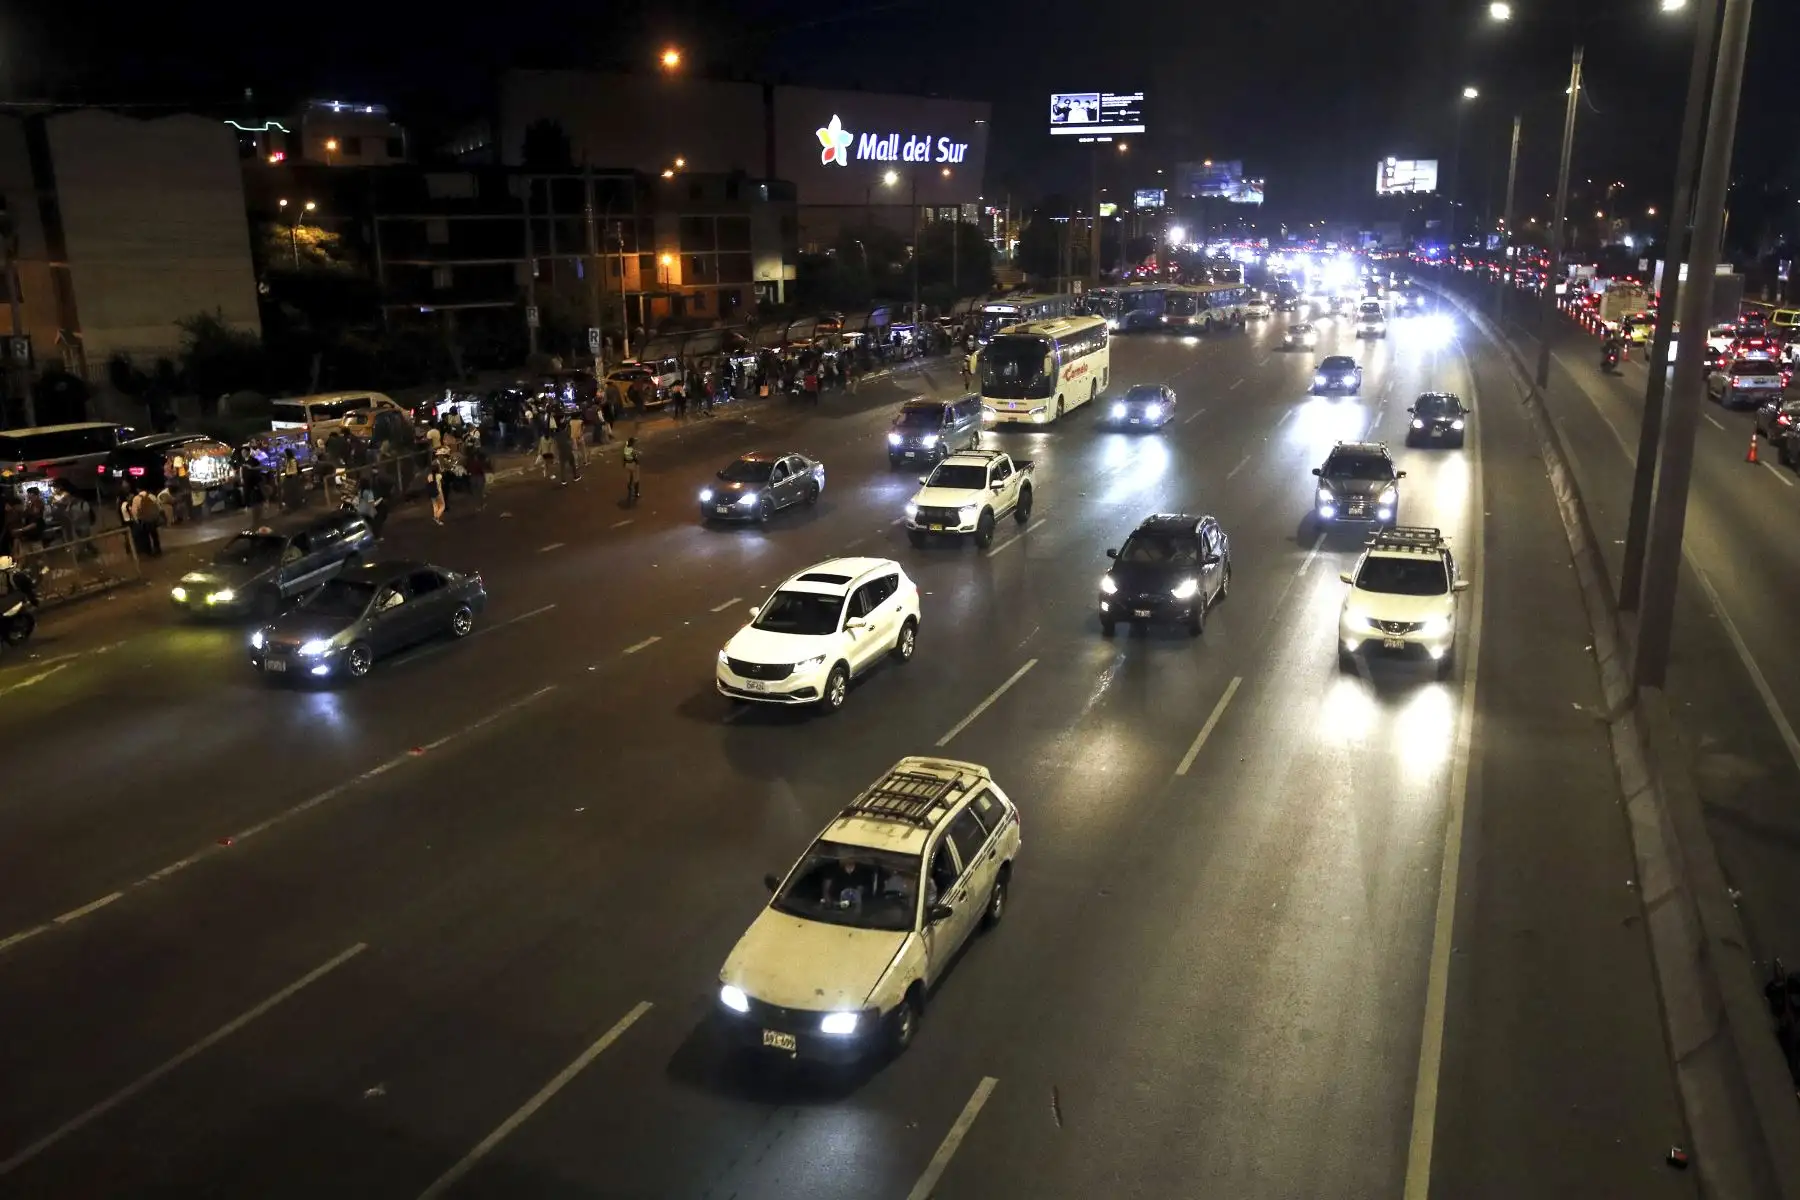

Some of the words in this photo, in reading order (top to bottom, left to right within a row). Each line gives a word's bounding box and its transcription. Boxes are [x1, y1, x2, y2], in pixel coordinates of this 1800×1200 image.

[856, 132, 900, 162] Mall
[902, 134, 931, 163] del
[935, 136, 968, 164] Sur
[590, 329, 599, 342] R
